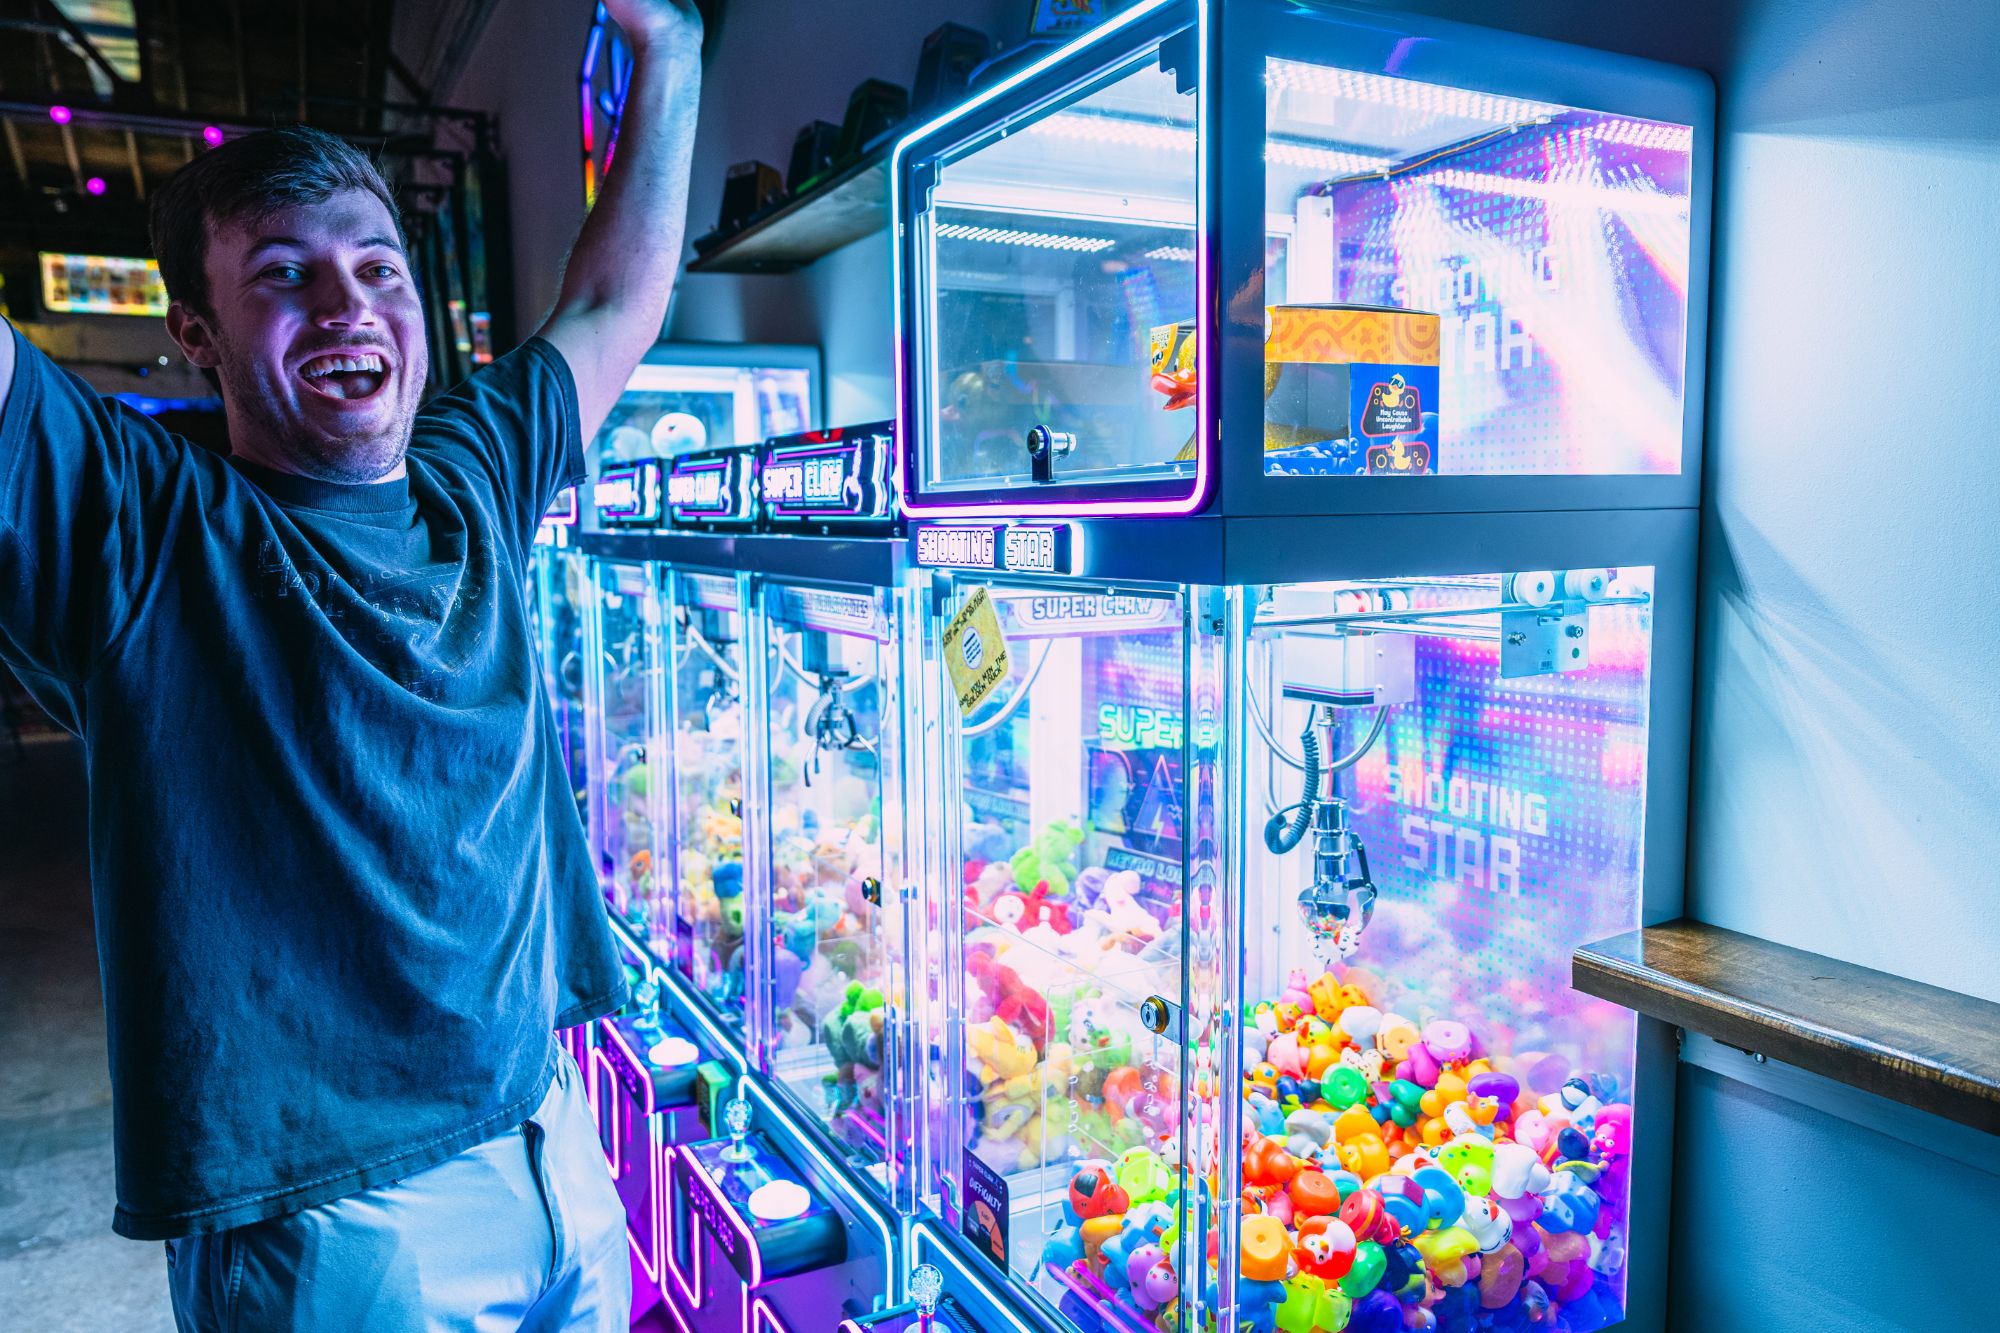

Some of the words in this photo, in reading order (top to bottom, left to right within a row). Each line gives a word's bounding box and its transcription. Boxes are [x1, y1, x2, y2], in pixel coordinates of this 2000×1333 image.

[763, 463, 803, 500] SUPER
[804, 459, 843, 500] CLAW
[918, 529, 994, 566] SHOOTING
[1006, 530, 1053, 568] STAR
[1032, 595, 1097, 619] SUPER
[1102, 594, 1152, 616] CLAW
[1383, 764, 1548, 838] SHOOTING
[1402, 814, 1521, 899] STAR
[969, 1177, 1002, 1212] DIFFICULTY
